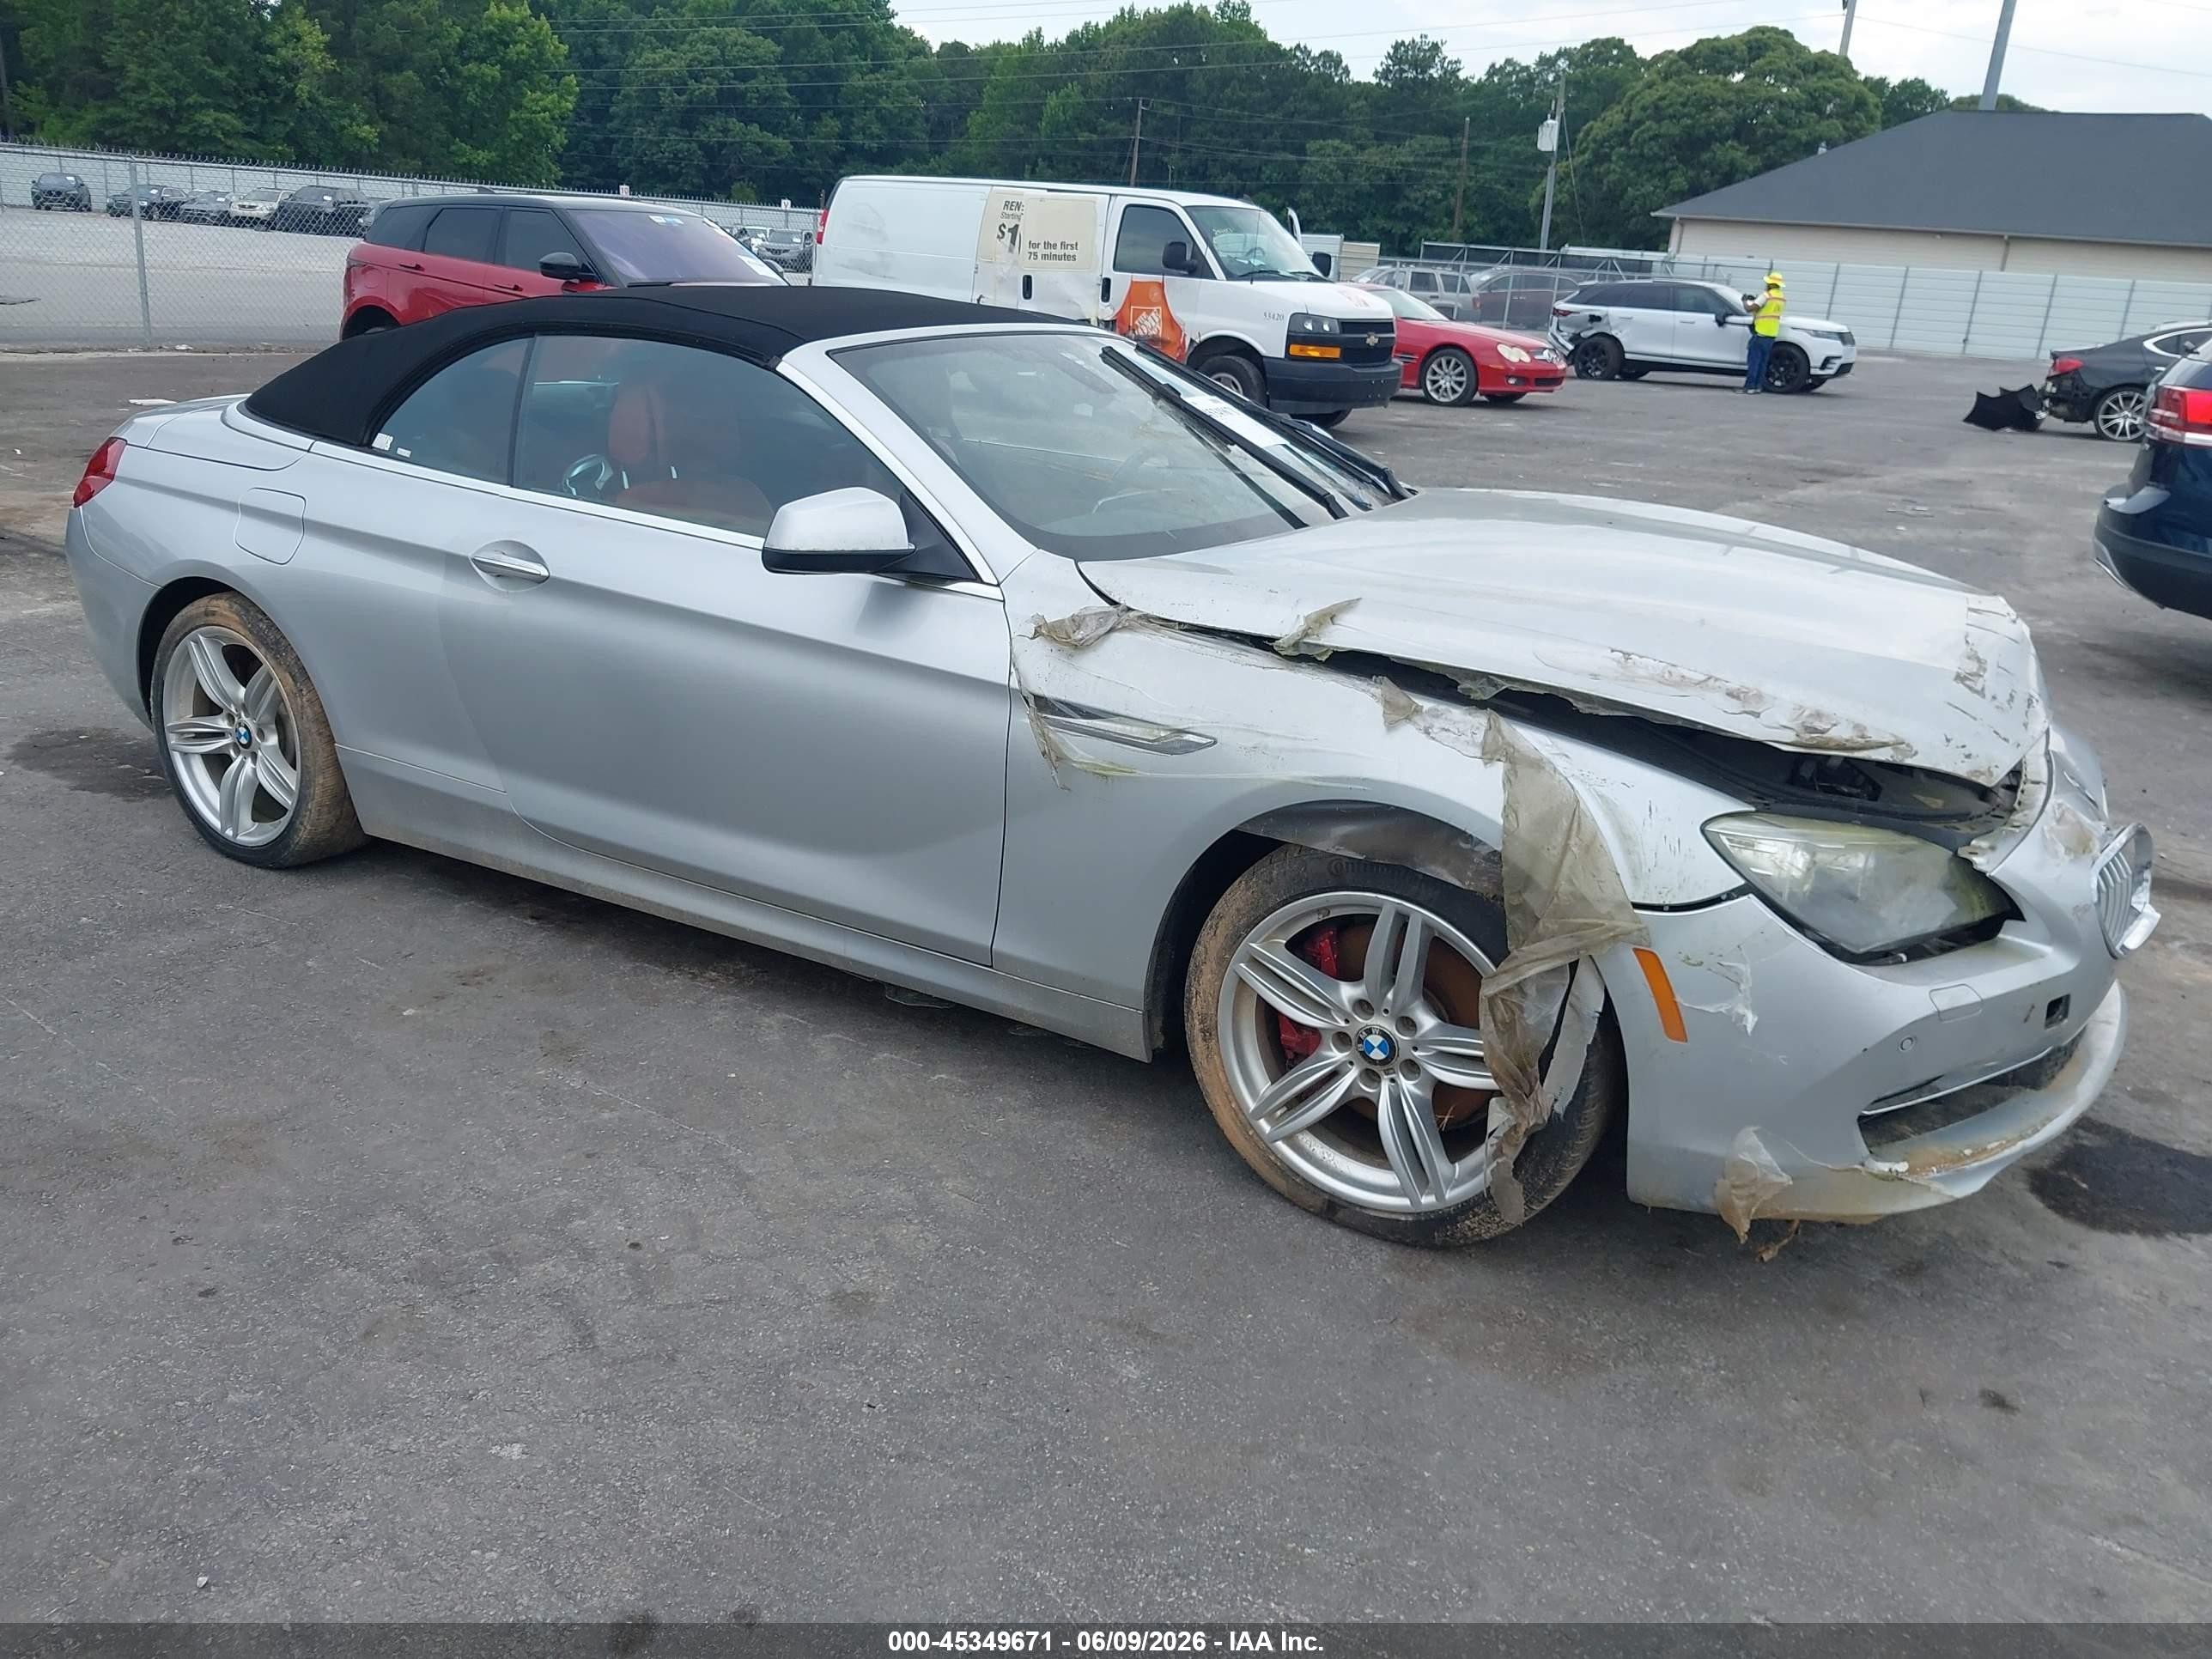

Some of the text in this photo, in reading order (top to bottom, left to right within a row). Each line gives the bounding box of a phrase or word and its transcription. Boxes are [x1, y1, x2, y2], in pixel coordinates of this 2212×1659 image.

[1003, 200, 1024, 211] REN
[996, 222, 1022, 254] $1
[1028, 240, 1079, 251] for the first
[1028, 252, 1077, 261] 75 minutes
